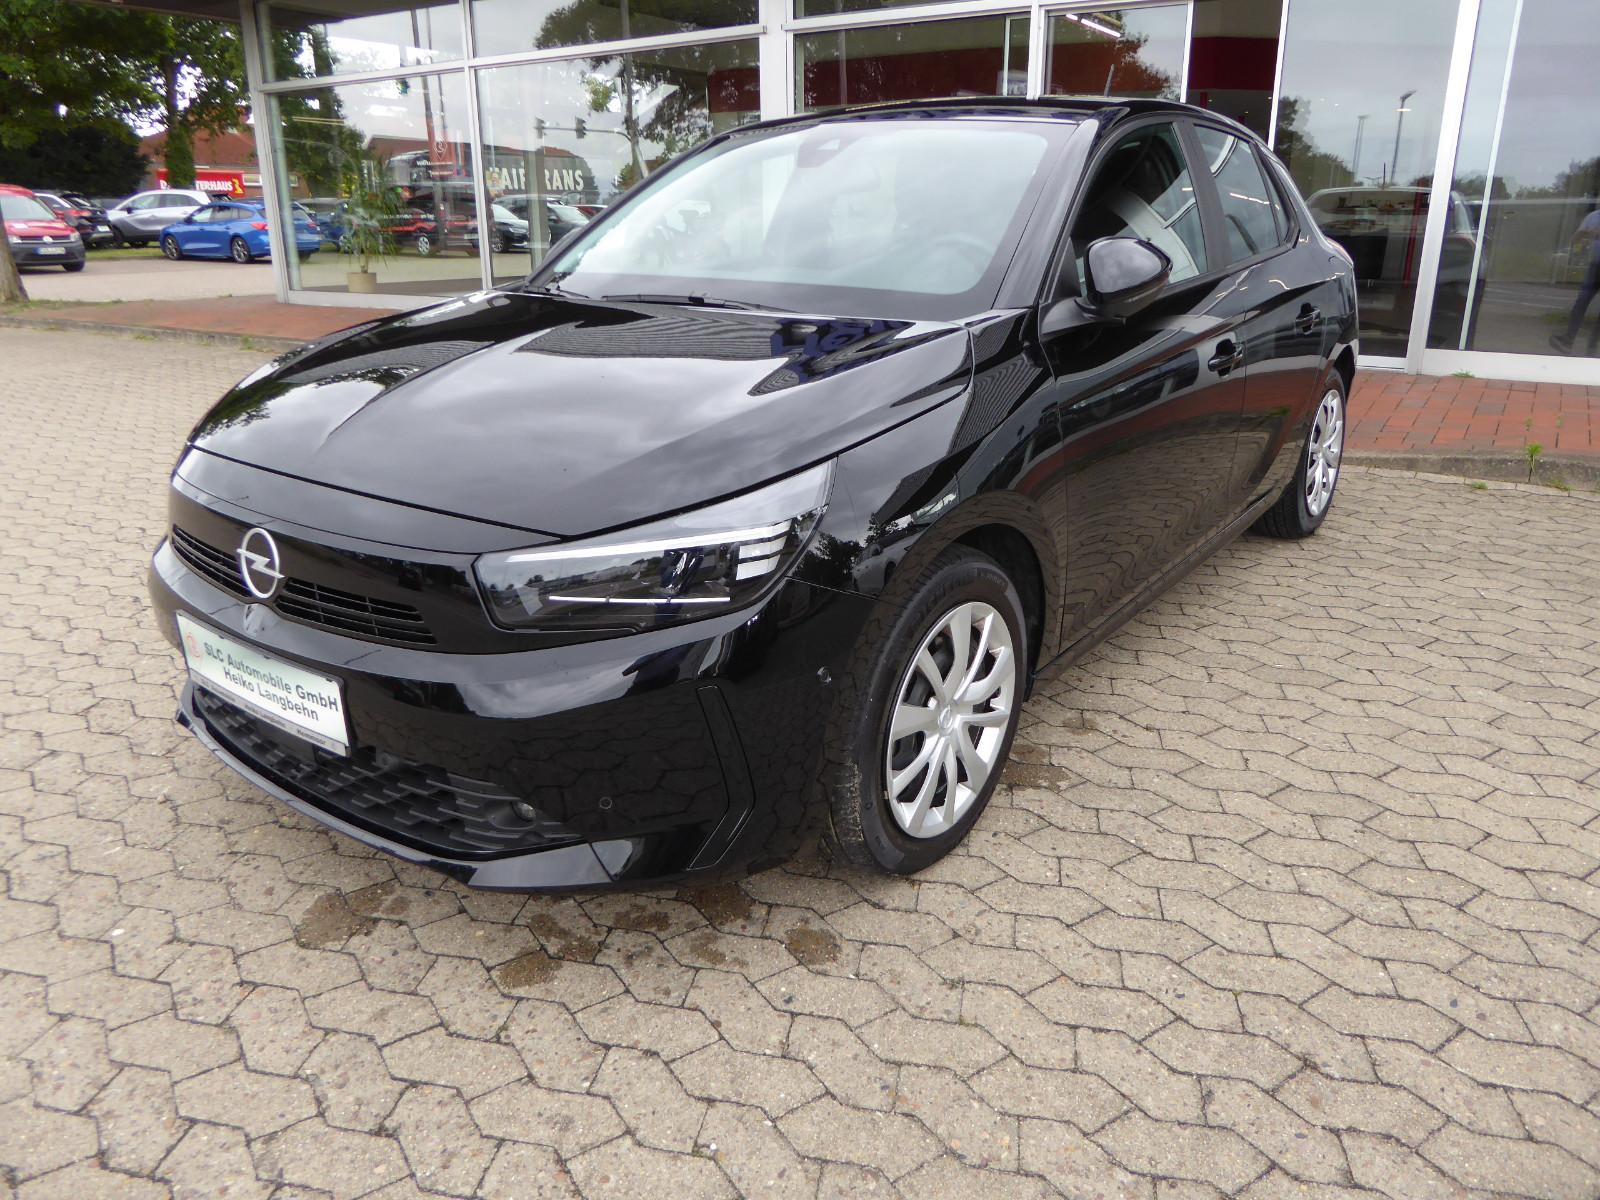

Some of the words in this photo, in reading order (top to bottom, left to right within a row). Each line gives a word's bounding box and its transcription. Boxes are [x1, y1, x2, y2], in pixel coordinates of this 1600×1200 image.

[195, 181, 233, 191] TERHAUS
[203, 642, 224, 662] SLC
[227, 653, 292, 693] Automobile
[295, 685, 339, 712] GmbH
[223, 667, 255, 692] Heiko
[257, 683, 319, 721] Langbehn
